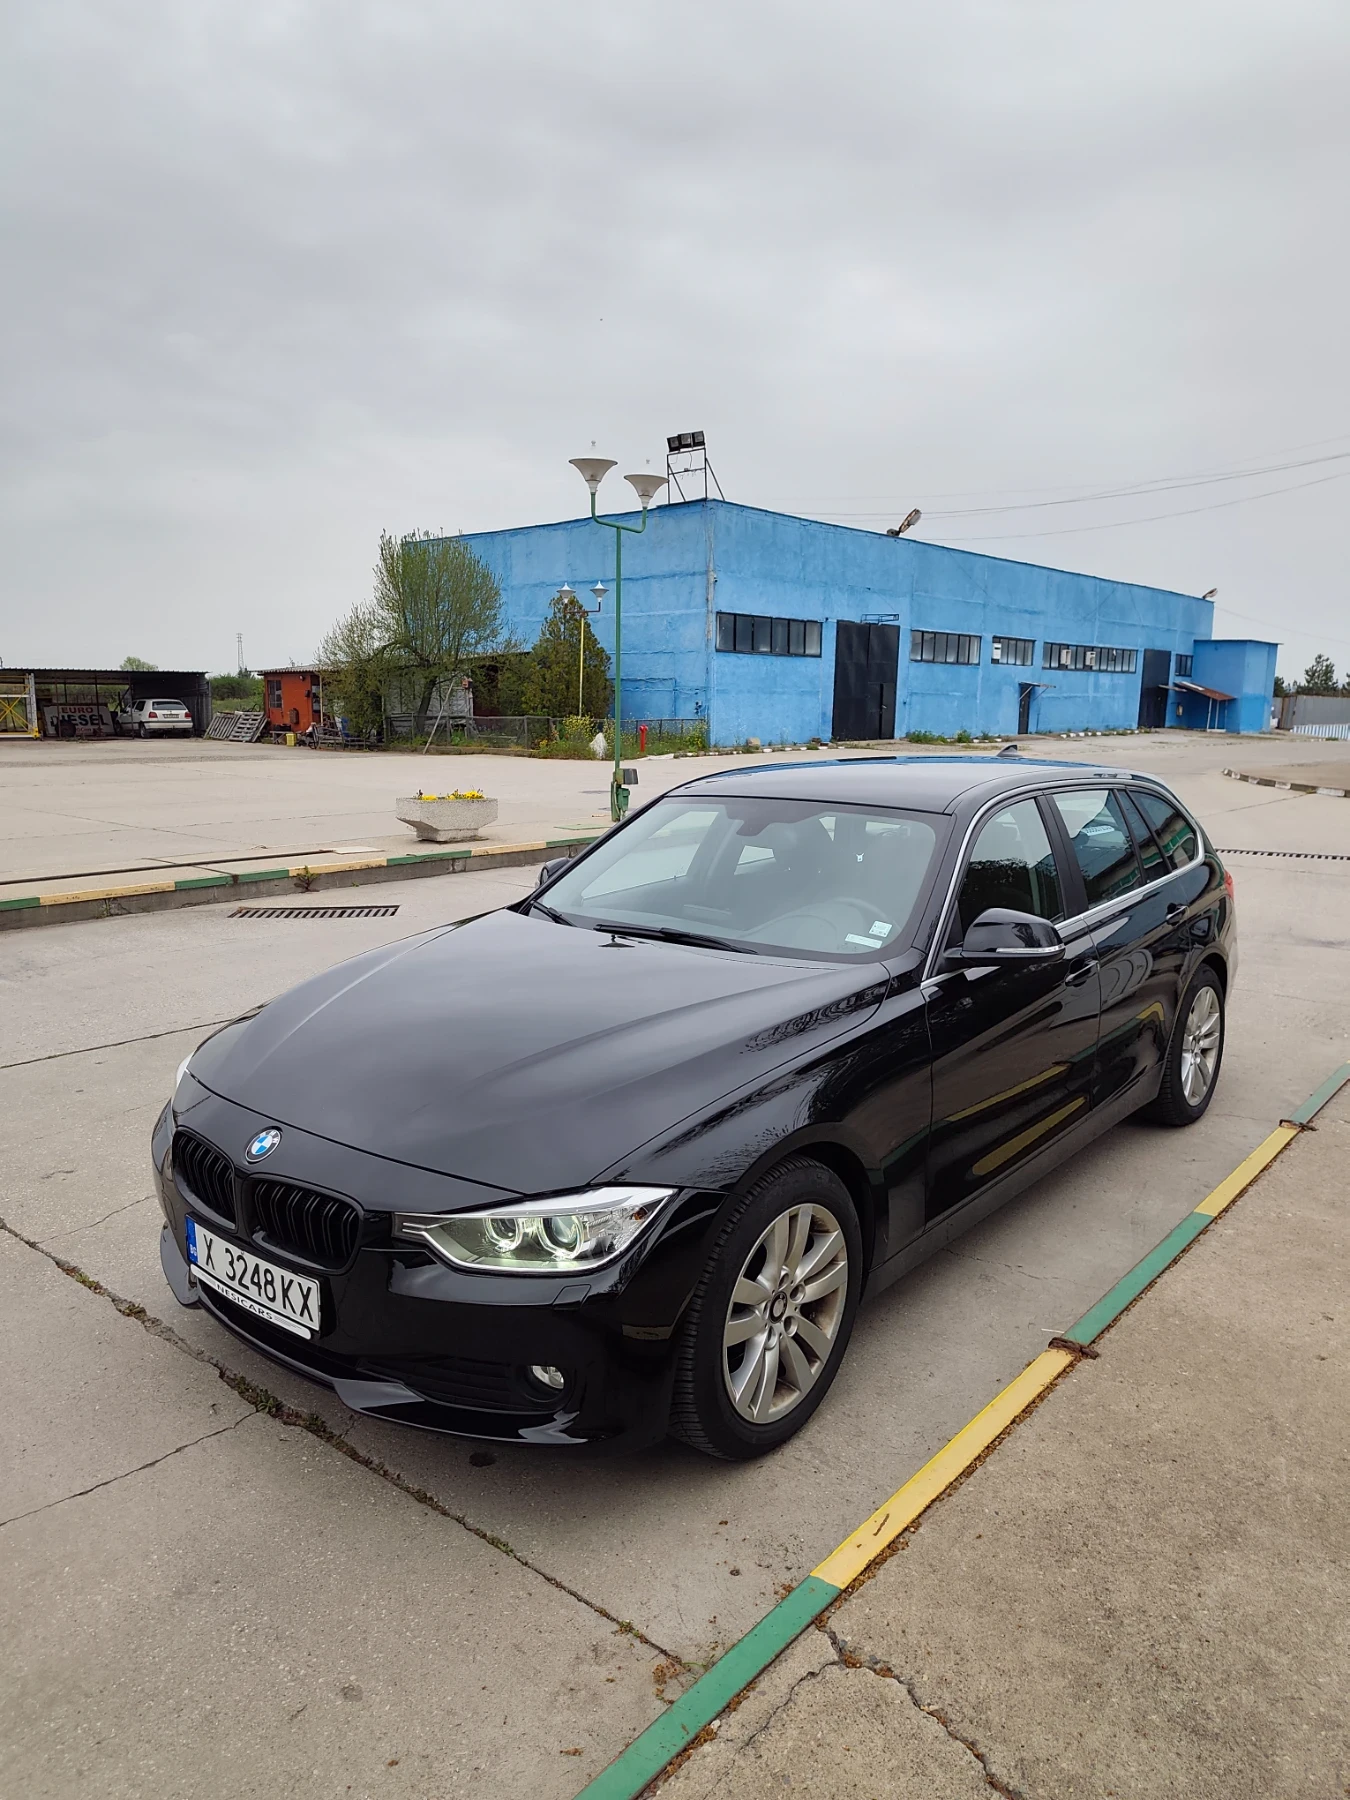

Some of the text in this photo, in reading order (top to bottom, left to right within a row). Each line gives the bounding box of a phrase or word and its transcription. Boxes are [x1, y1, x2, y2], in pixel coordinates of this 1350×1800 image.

[61, 706, 94, 714] EURO
[202, 1233, 215, 1271] X
[216, 1283, 273, 1321] NESICARS
